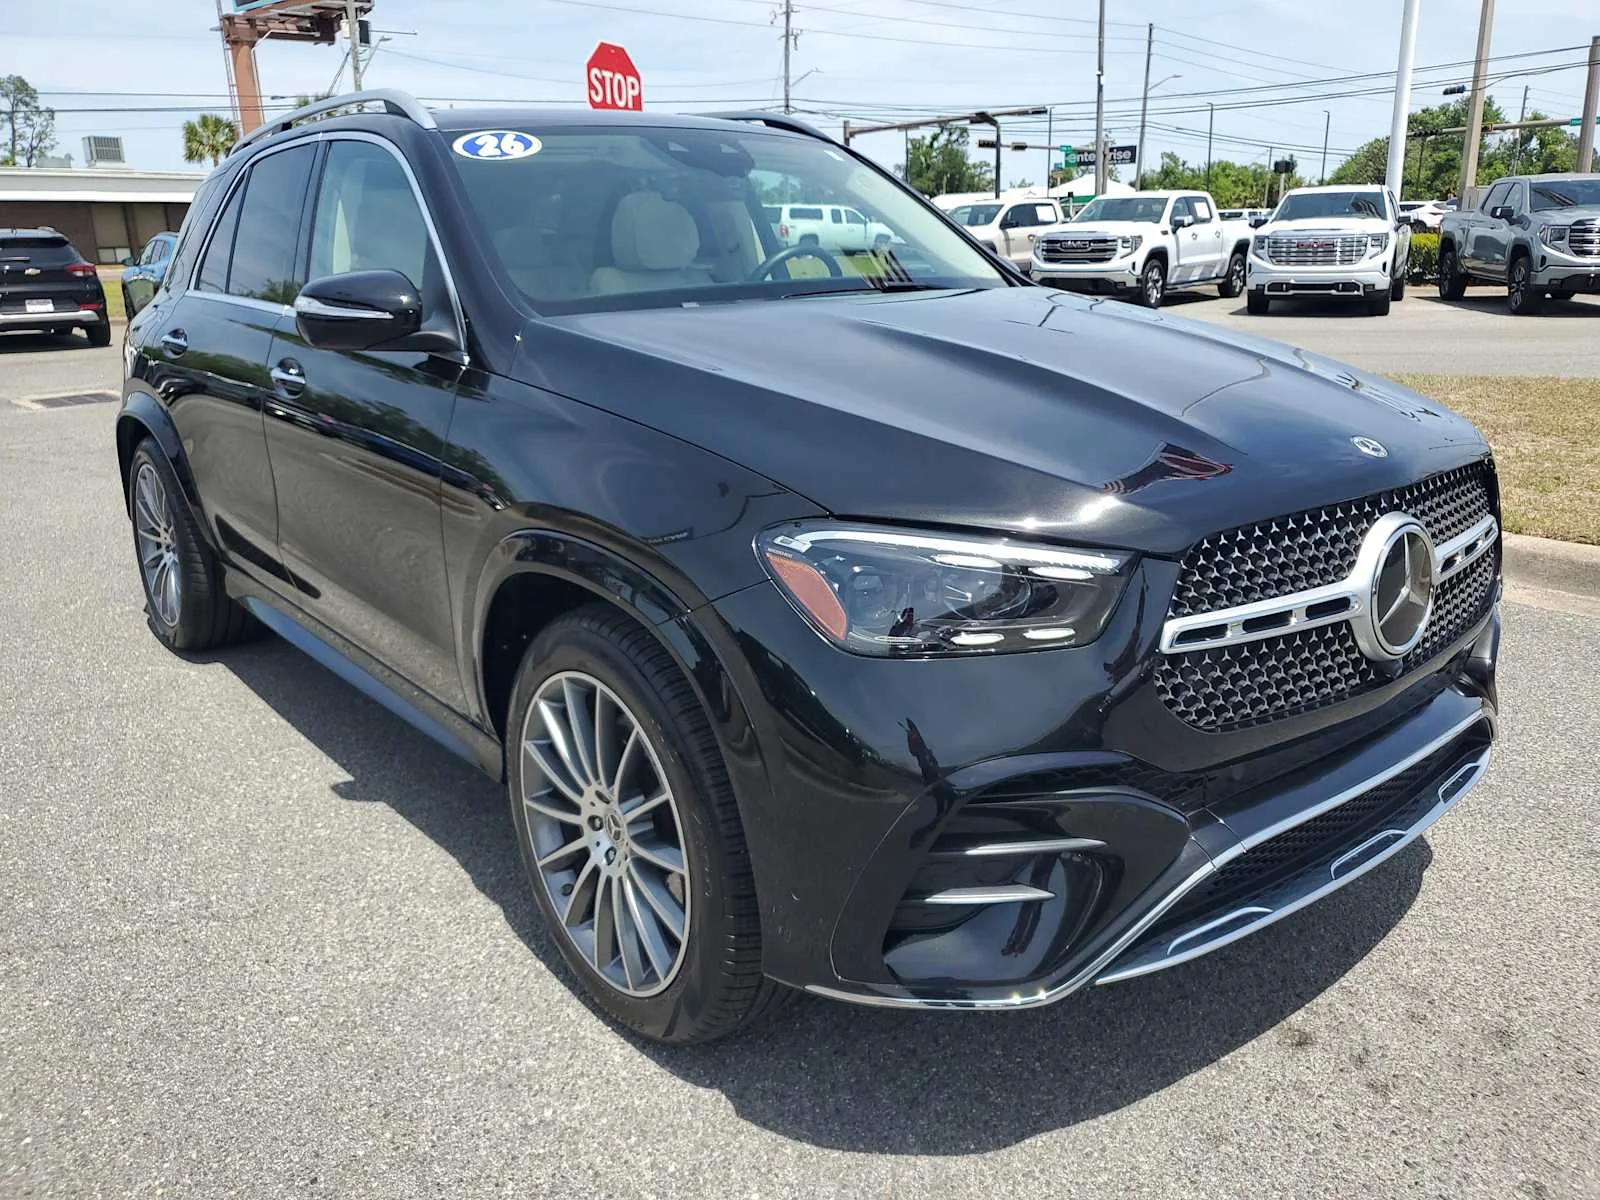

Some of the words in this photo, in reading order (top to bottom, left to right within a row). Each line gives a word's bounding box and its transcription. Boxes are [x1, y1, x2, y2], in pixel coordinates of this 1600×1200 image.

[589, 67, 640, 109] STOP
[475, 133, 525, 157] 26
[1066, 149, 1132, 163] enterise
